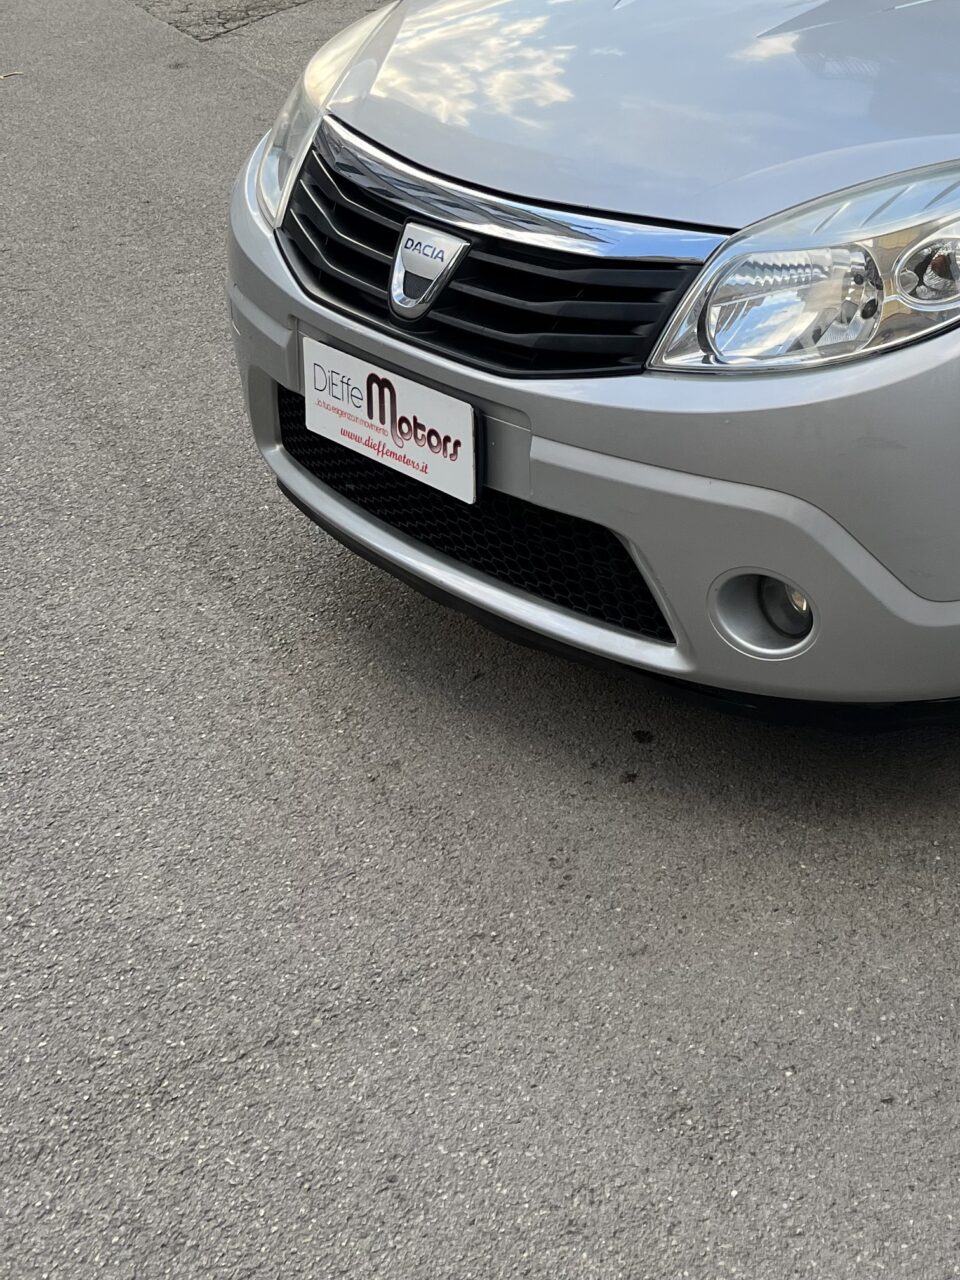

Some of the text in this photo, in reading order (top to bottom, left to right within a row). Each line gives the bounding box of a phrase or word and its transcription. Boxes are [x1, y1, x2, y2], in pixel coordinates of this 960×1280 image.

[404, 236, 445, 263] DACIA
[313, 362, 364, 409] DiEffe
[340, 427, 428, 475] www.dieffemotors.it
